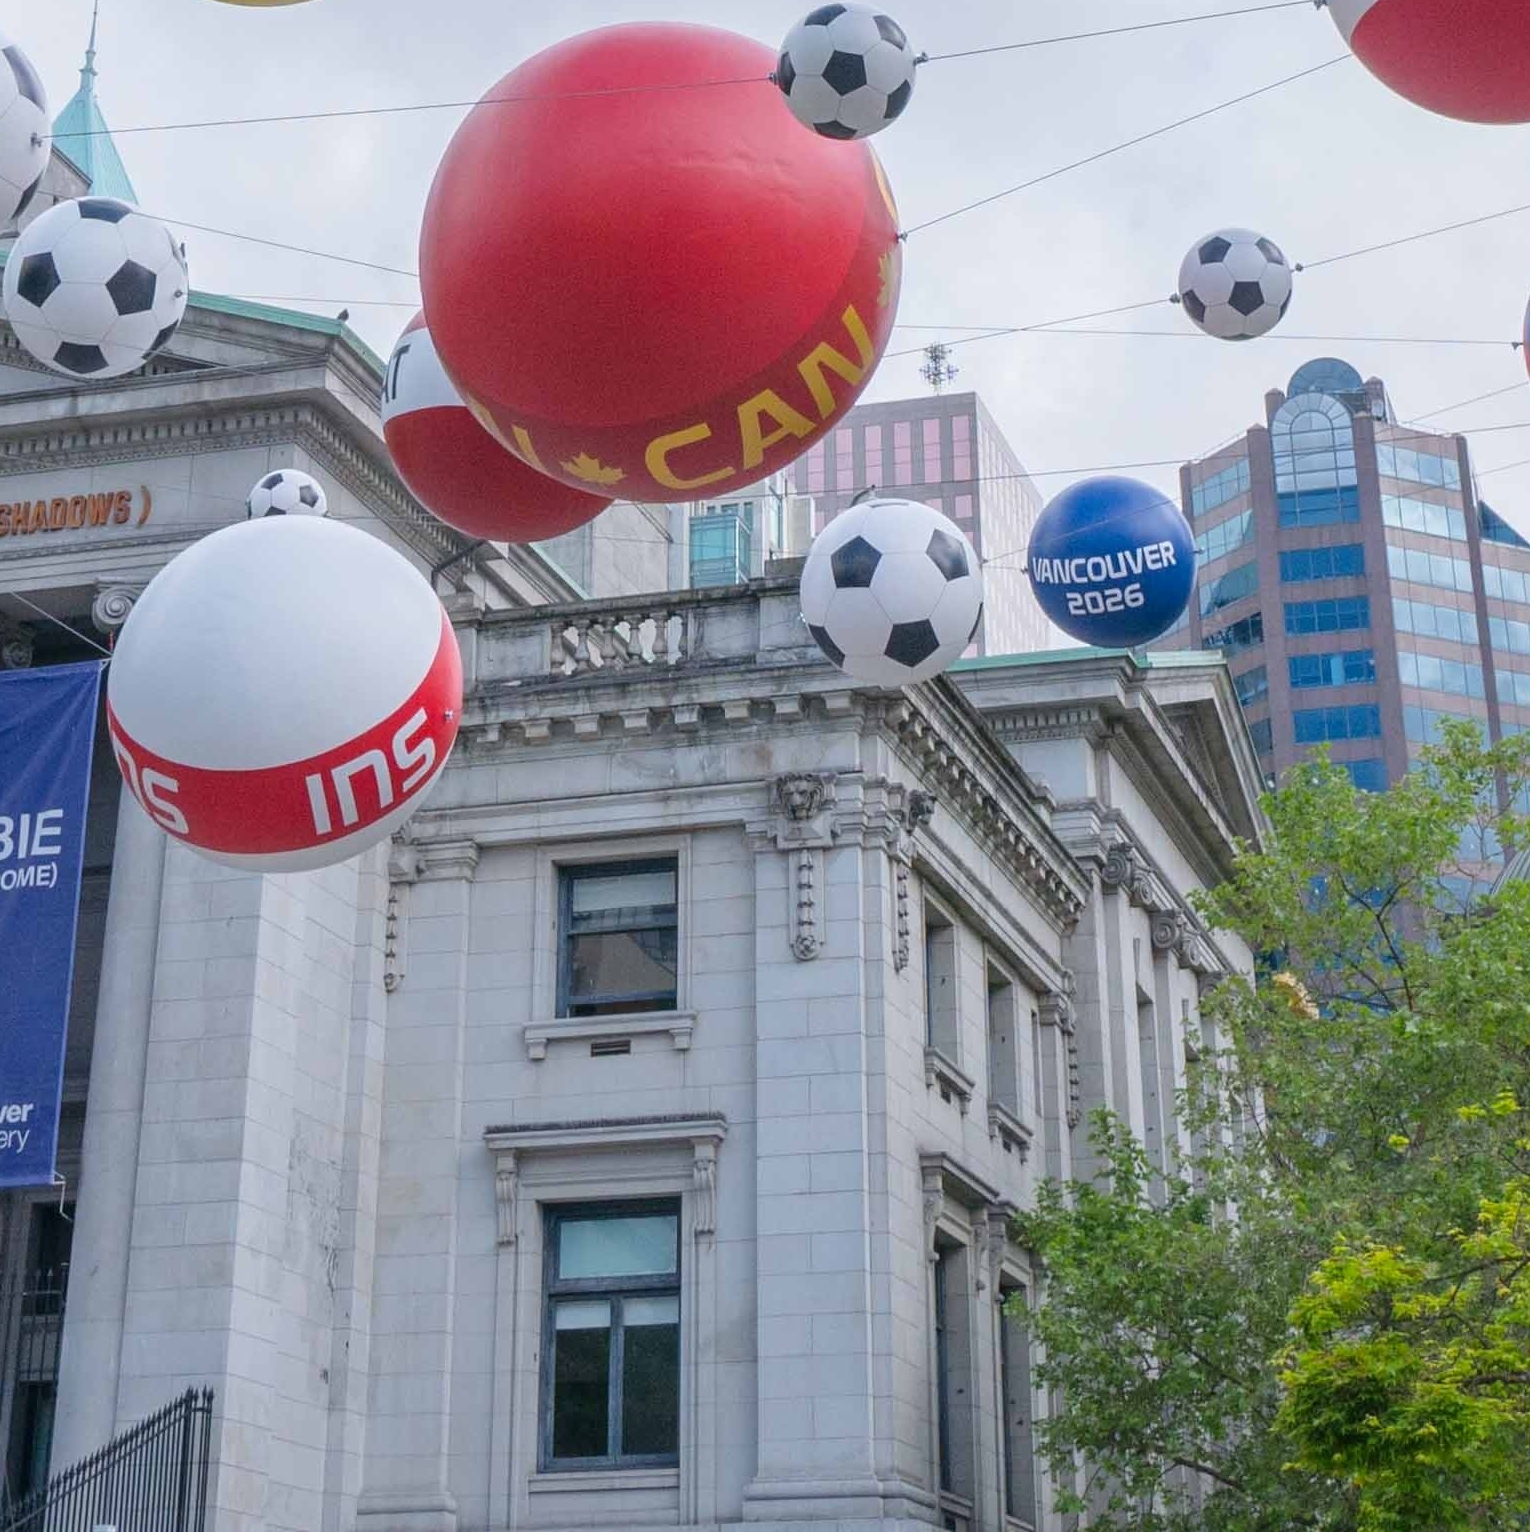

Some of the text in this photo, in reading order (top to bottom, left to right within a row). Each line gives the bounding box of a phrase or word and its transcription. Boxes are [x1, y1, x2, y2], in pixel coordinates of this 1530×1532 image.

[645, 304, 875, 490] CAN
[1032, 541, 1177, 584] VANCOUVER
[1066, 583, 1145, 615] 2026
[111, 729, 190, 835] SU
[305, 708, 437, 836] SUI
